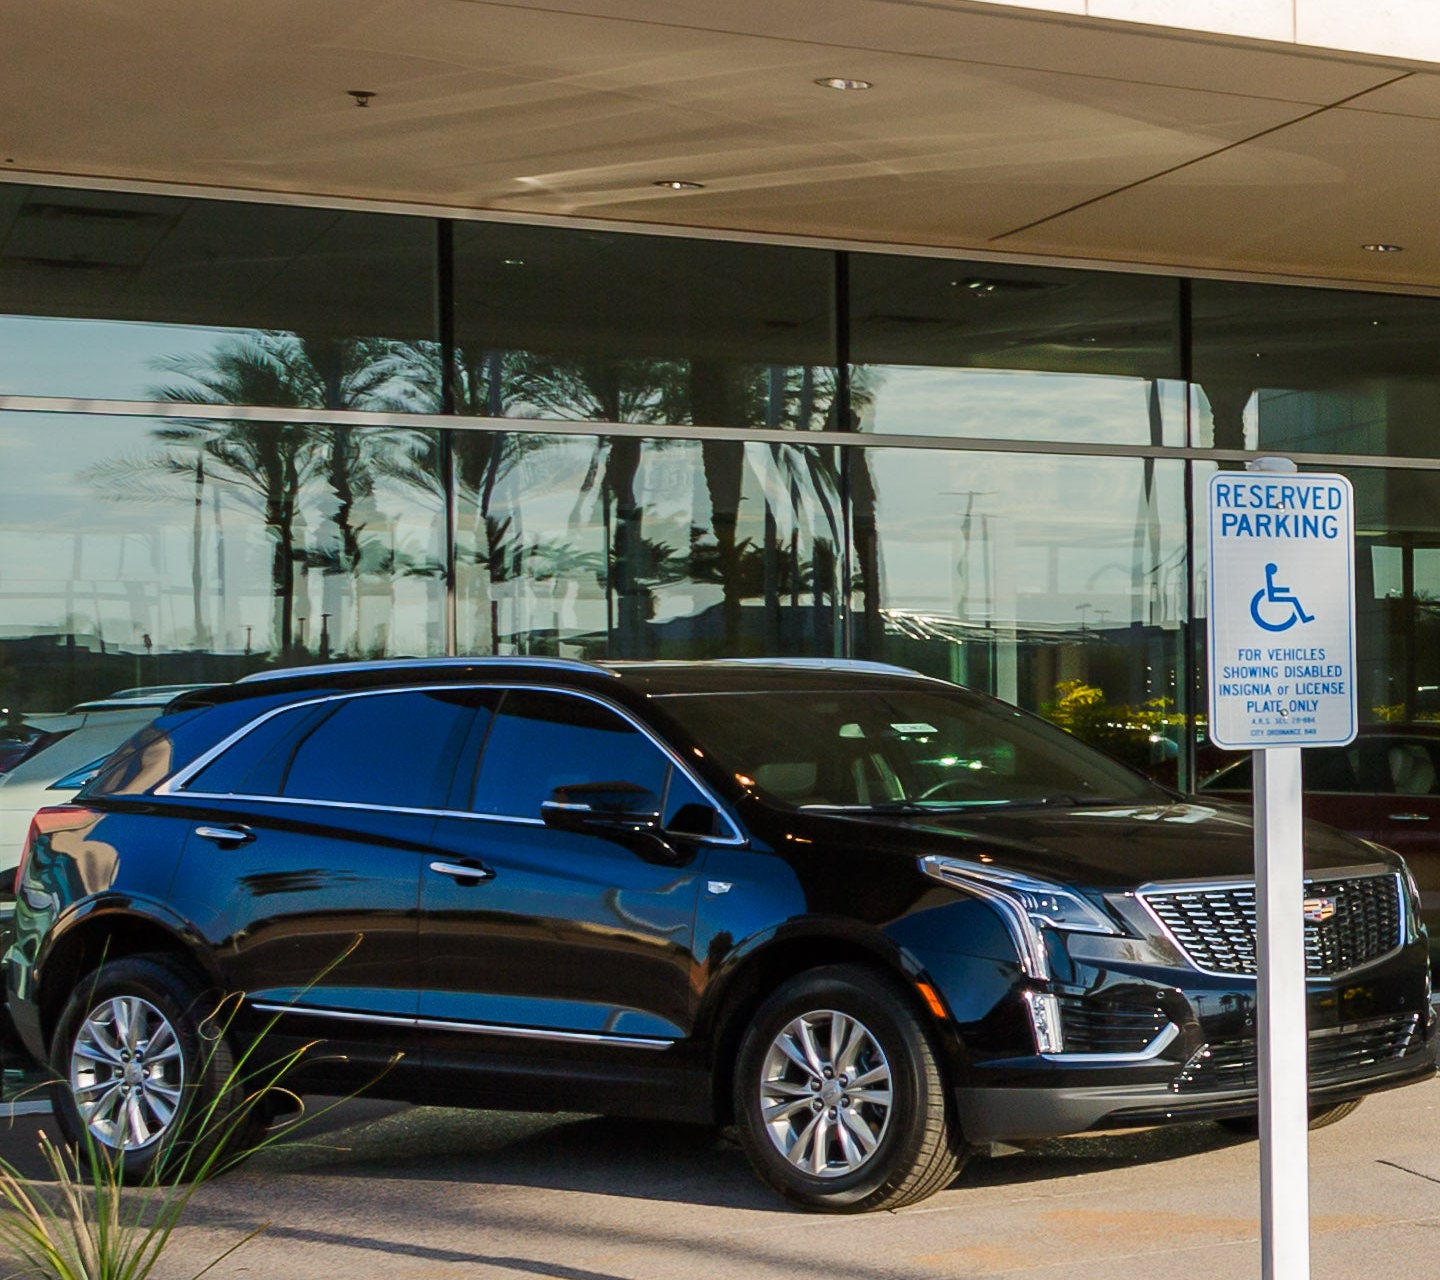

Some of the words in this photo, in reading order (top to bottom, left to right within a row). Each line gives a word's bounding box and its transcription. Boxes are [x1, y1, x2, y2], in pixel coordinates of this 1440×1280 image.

[1216, 484, 1342, 509] RESERVED
[1222, 513, 1338, 539] PARKING
[1238, 649, 1262, 661] FOR
[1267, 648, 1326, 661] VEHICLES
[1223, 666, 1279, 679] SHOWING
[1284, 665, 1343, 678] DISABLED
[1219, 683, 1272, 696] INSIGNIA
[1277, 685, 1289, 695] or
[1295, 682, 1345, 695] LICENSE
[1247, 700, 1282, 713] PLATE
[1289, 700, 1319, 712] ONLY
